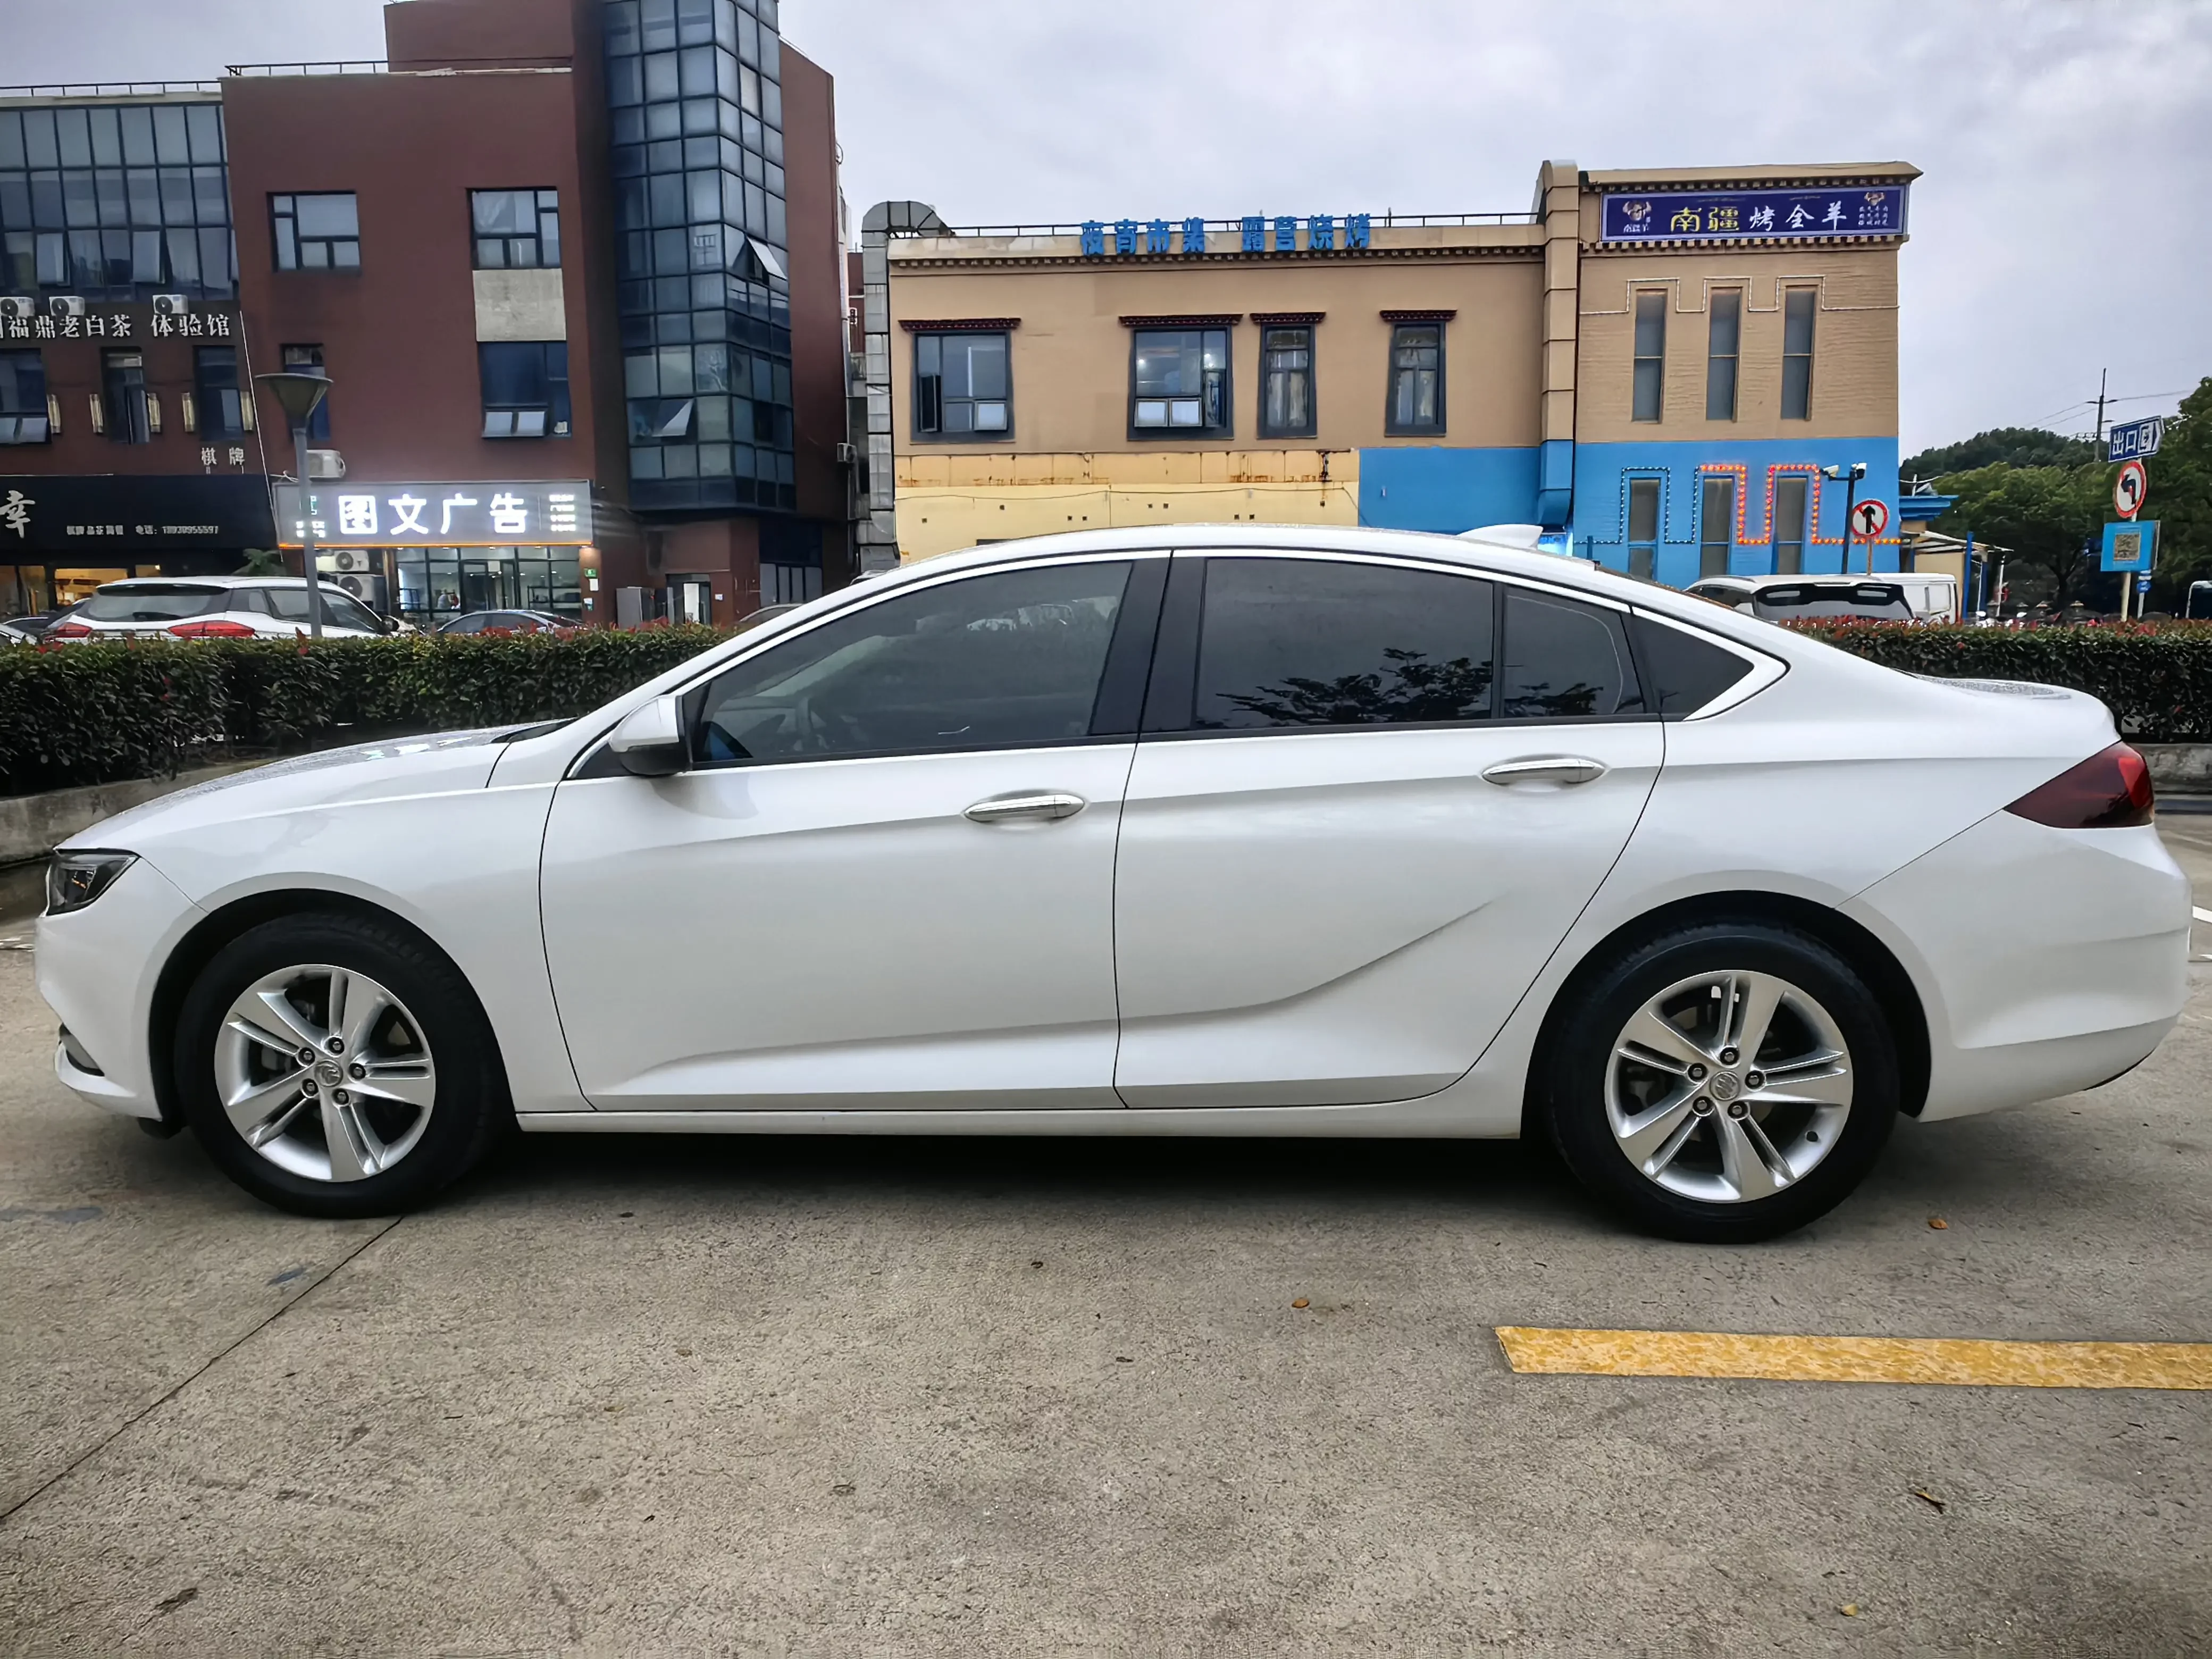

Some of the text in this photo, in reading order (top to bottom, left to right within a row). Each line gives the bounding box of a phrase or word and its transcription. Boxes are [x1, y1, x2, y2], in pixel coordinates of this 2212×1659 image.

[1671, 200, 1847, 232] 南疆烤全羊
[0, 313, 230, 339] 福鼎老白茶 体验馆
[202, 447, 245, 465] 棋牌
[2112, 430, 2138, 456] 出口
[338, 492, 528, 535] 图文广告
